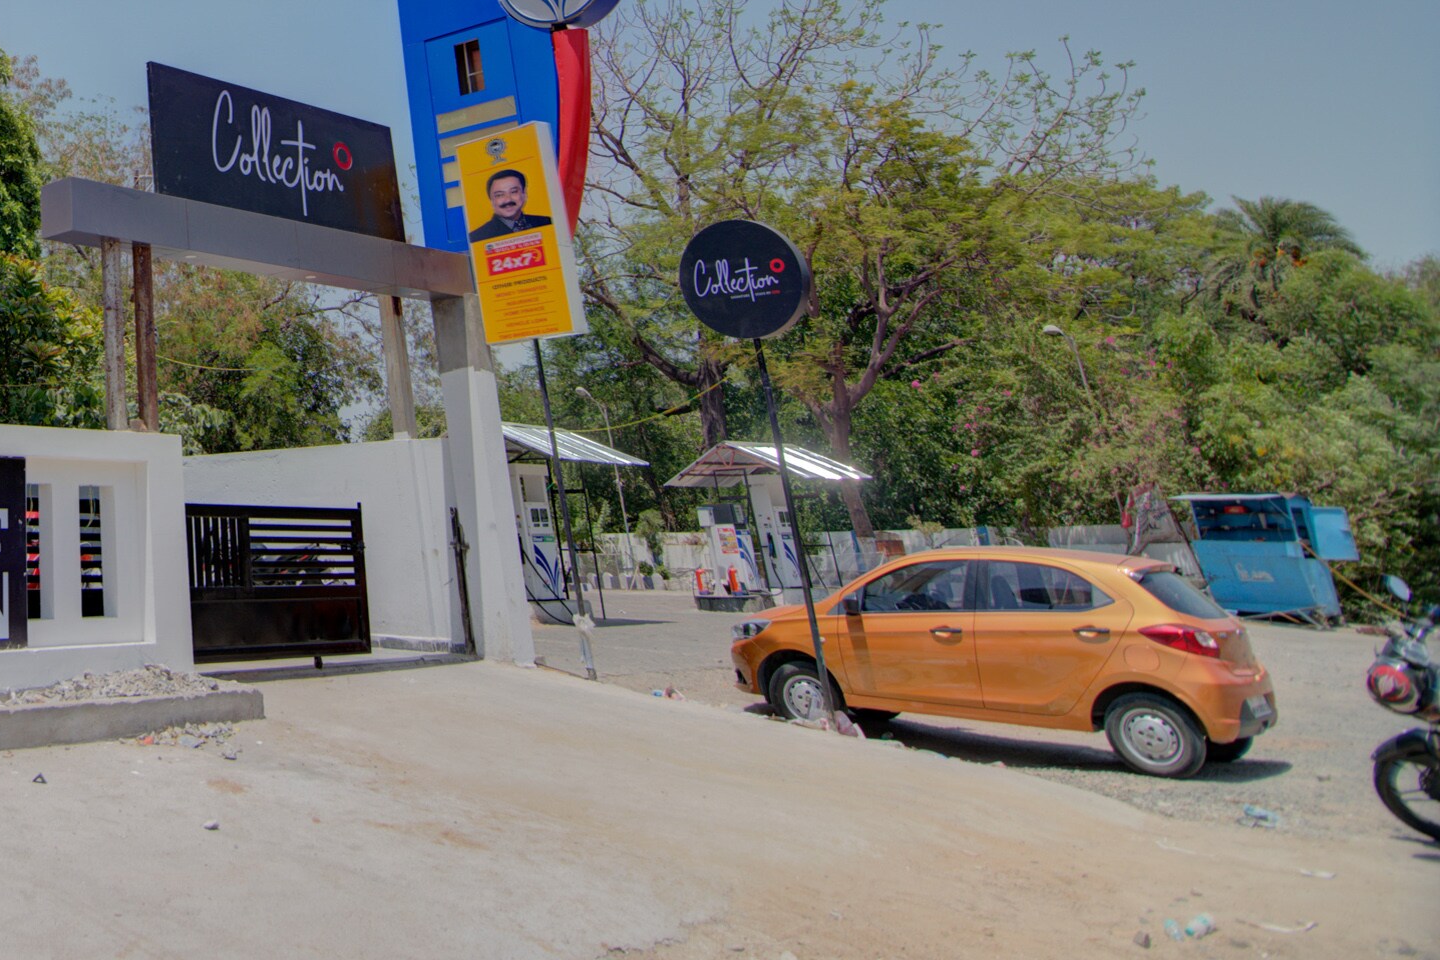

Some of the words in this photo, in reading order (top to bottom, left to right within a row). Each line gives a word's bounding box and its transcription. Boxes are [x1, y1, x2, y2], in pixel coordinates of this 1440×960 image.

[212, 90, 343, 216] Collection
[492, 252, 533, 272] 24x7
[693, 257, 779, 302] Collection
